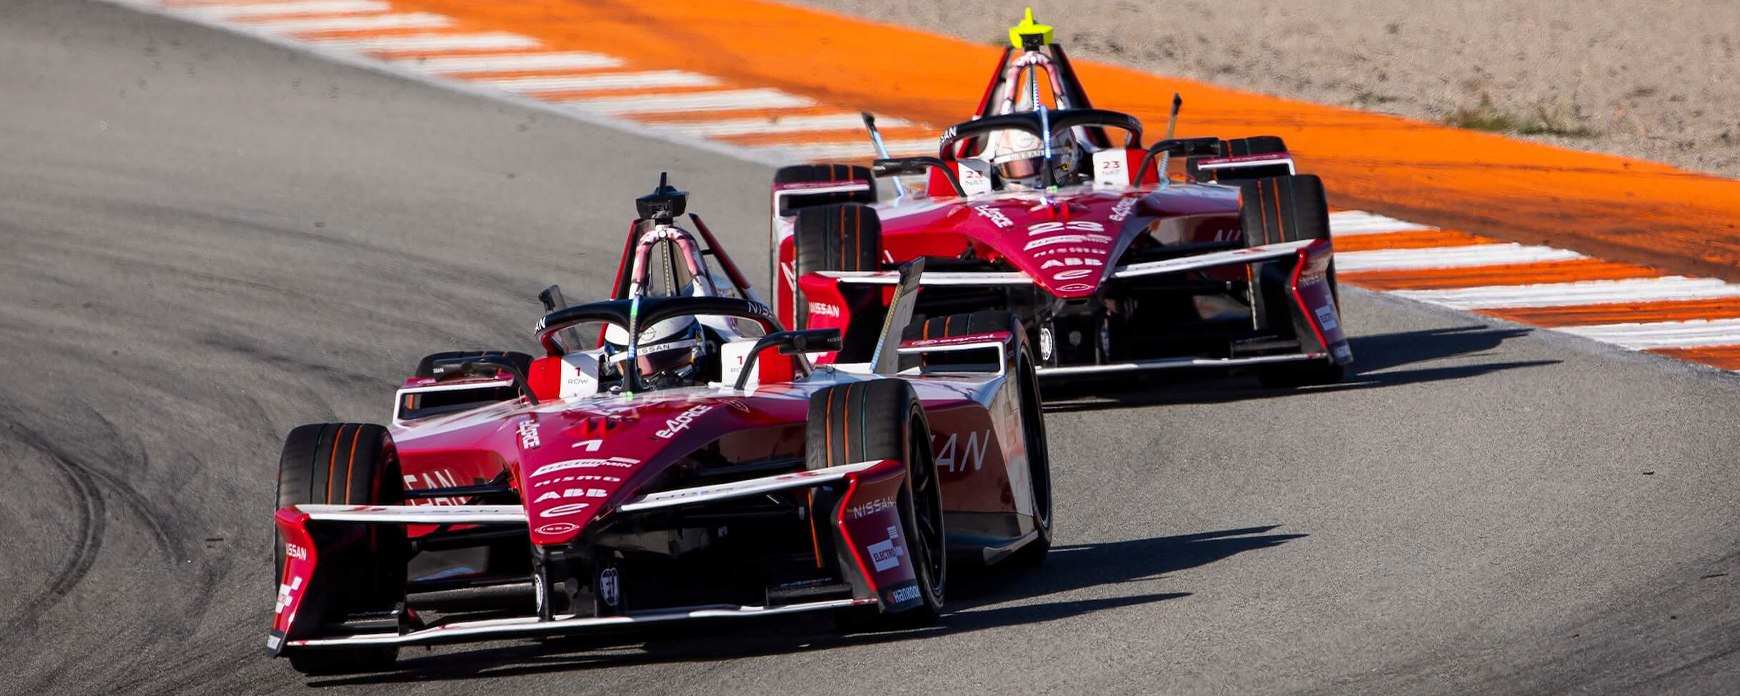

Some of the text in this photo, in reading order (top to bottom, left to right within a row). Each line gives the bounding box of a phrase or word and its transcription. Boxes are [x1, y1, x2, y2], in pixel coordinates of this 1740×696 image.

[1102, 161, 1120, 169] 23
[965, 170, 983, 179] 23
[1027, 221, 1105, 237] 23
[1040, 257, 1104, 270] ABB
[808, 301, 840, 318] NISSAN
[736, 355, 743, 366] 1
[574, 367, 581, 377] 1
[571, 439, 603, 452] 1
[533, 488, 608, 503] ABB
[853, 496, 897, 519] NISSAN
